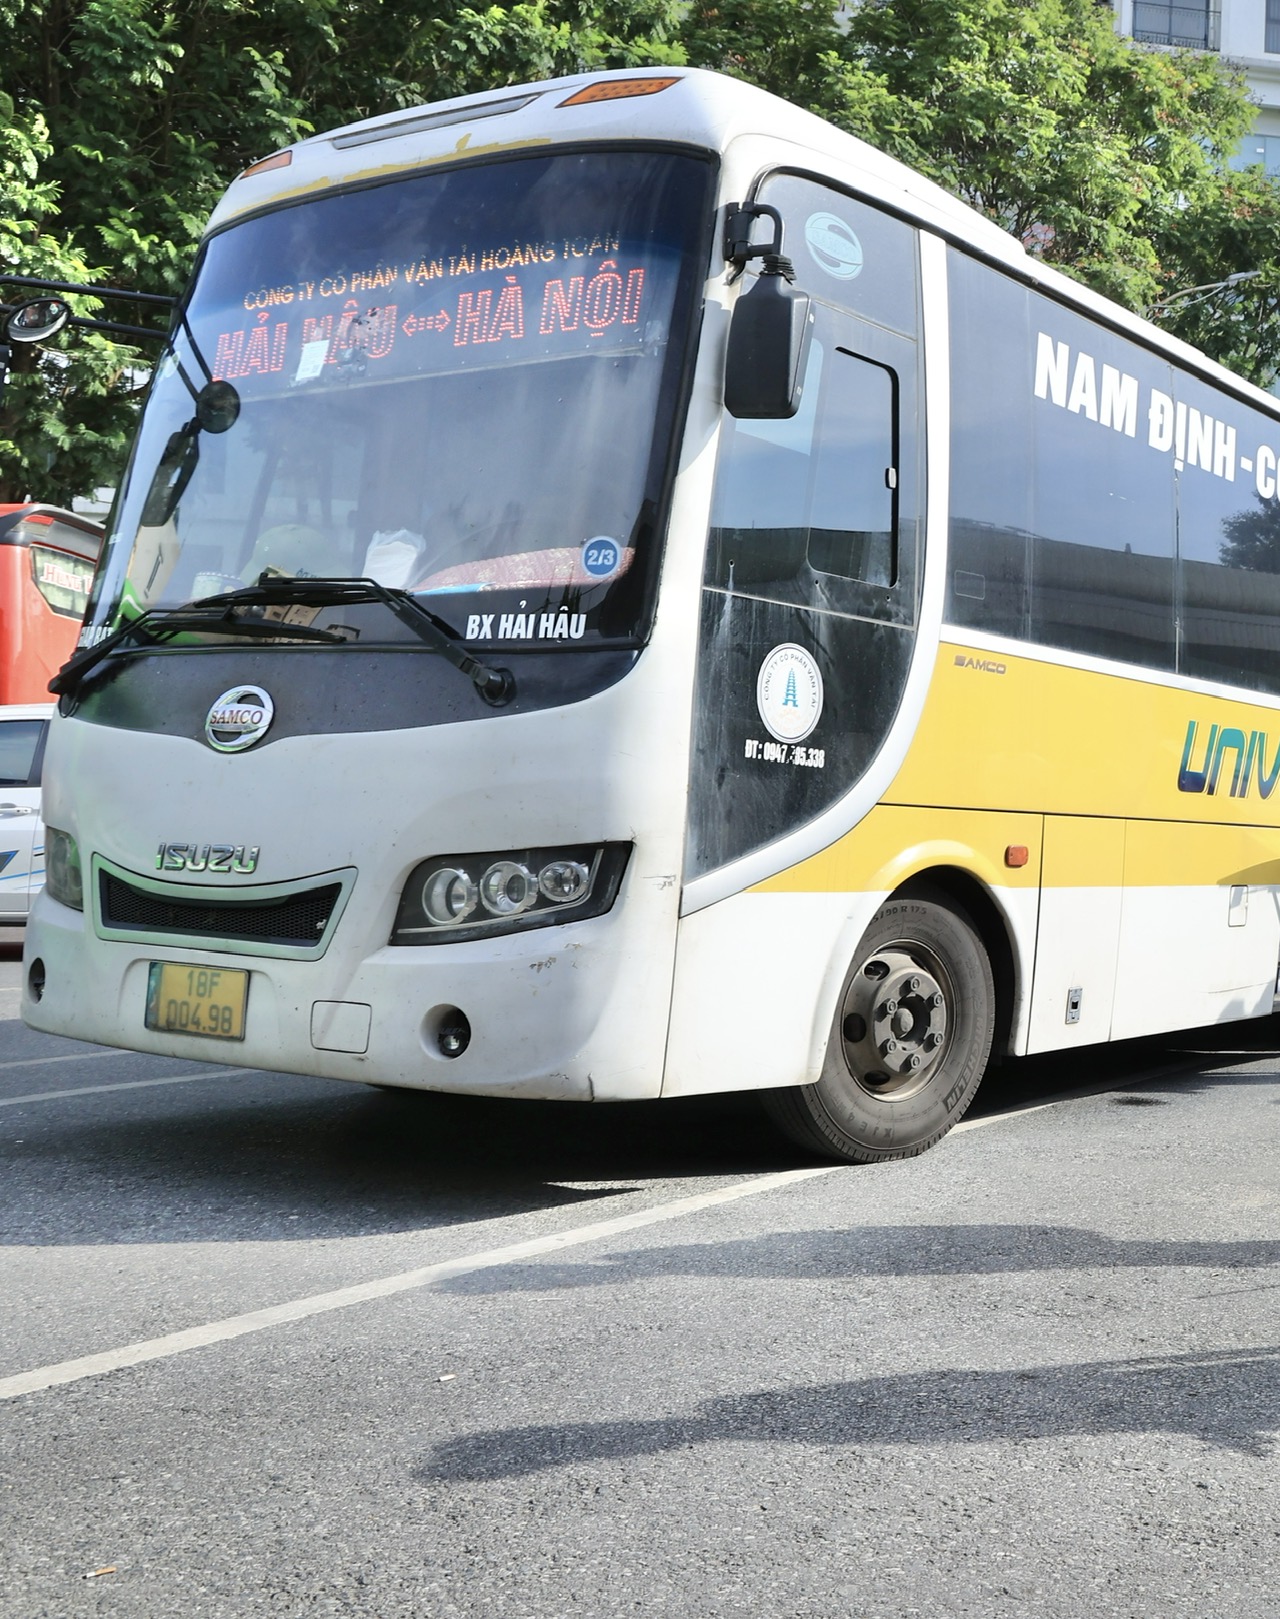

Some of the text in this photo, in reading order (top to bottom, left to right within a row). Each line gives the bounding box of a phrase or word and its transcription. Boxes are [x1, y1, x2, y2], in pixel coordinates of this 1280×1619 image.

[212, 311, 288, 382] HẢI
[454, 275, 525, 346] HÀ
[539, 259, 645, 338] NỘI
[1034, 331, 1139, 438] NAM
[587, 549, 614, 566] 2/3
[466, 600, 587, 643] BX HẢI HẬU
[954, 655, 1006, 675] SAMCO
[210, 709, 263, 725] SAMCO
[155, 843, 260, 874] ISUZU
[187, 970, 221, 999] 18F
[165, 999, 233, 1034] 004.98
[946, 1017, 984, 1113] MICHELIN
